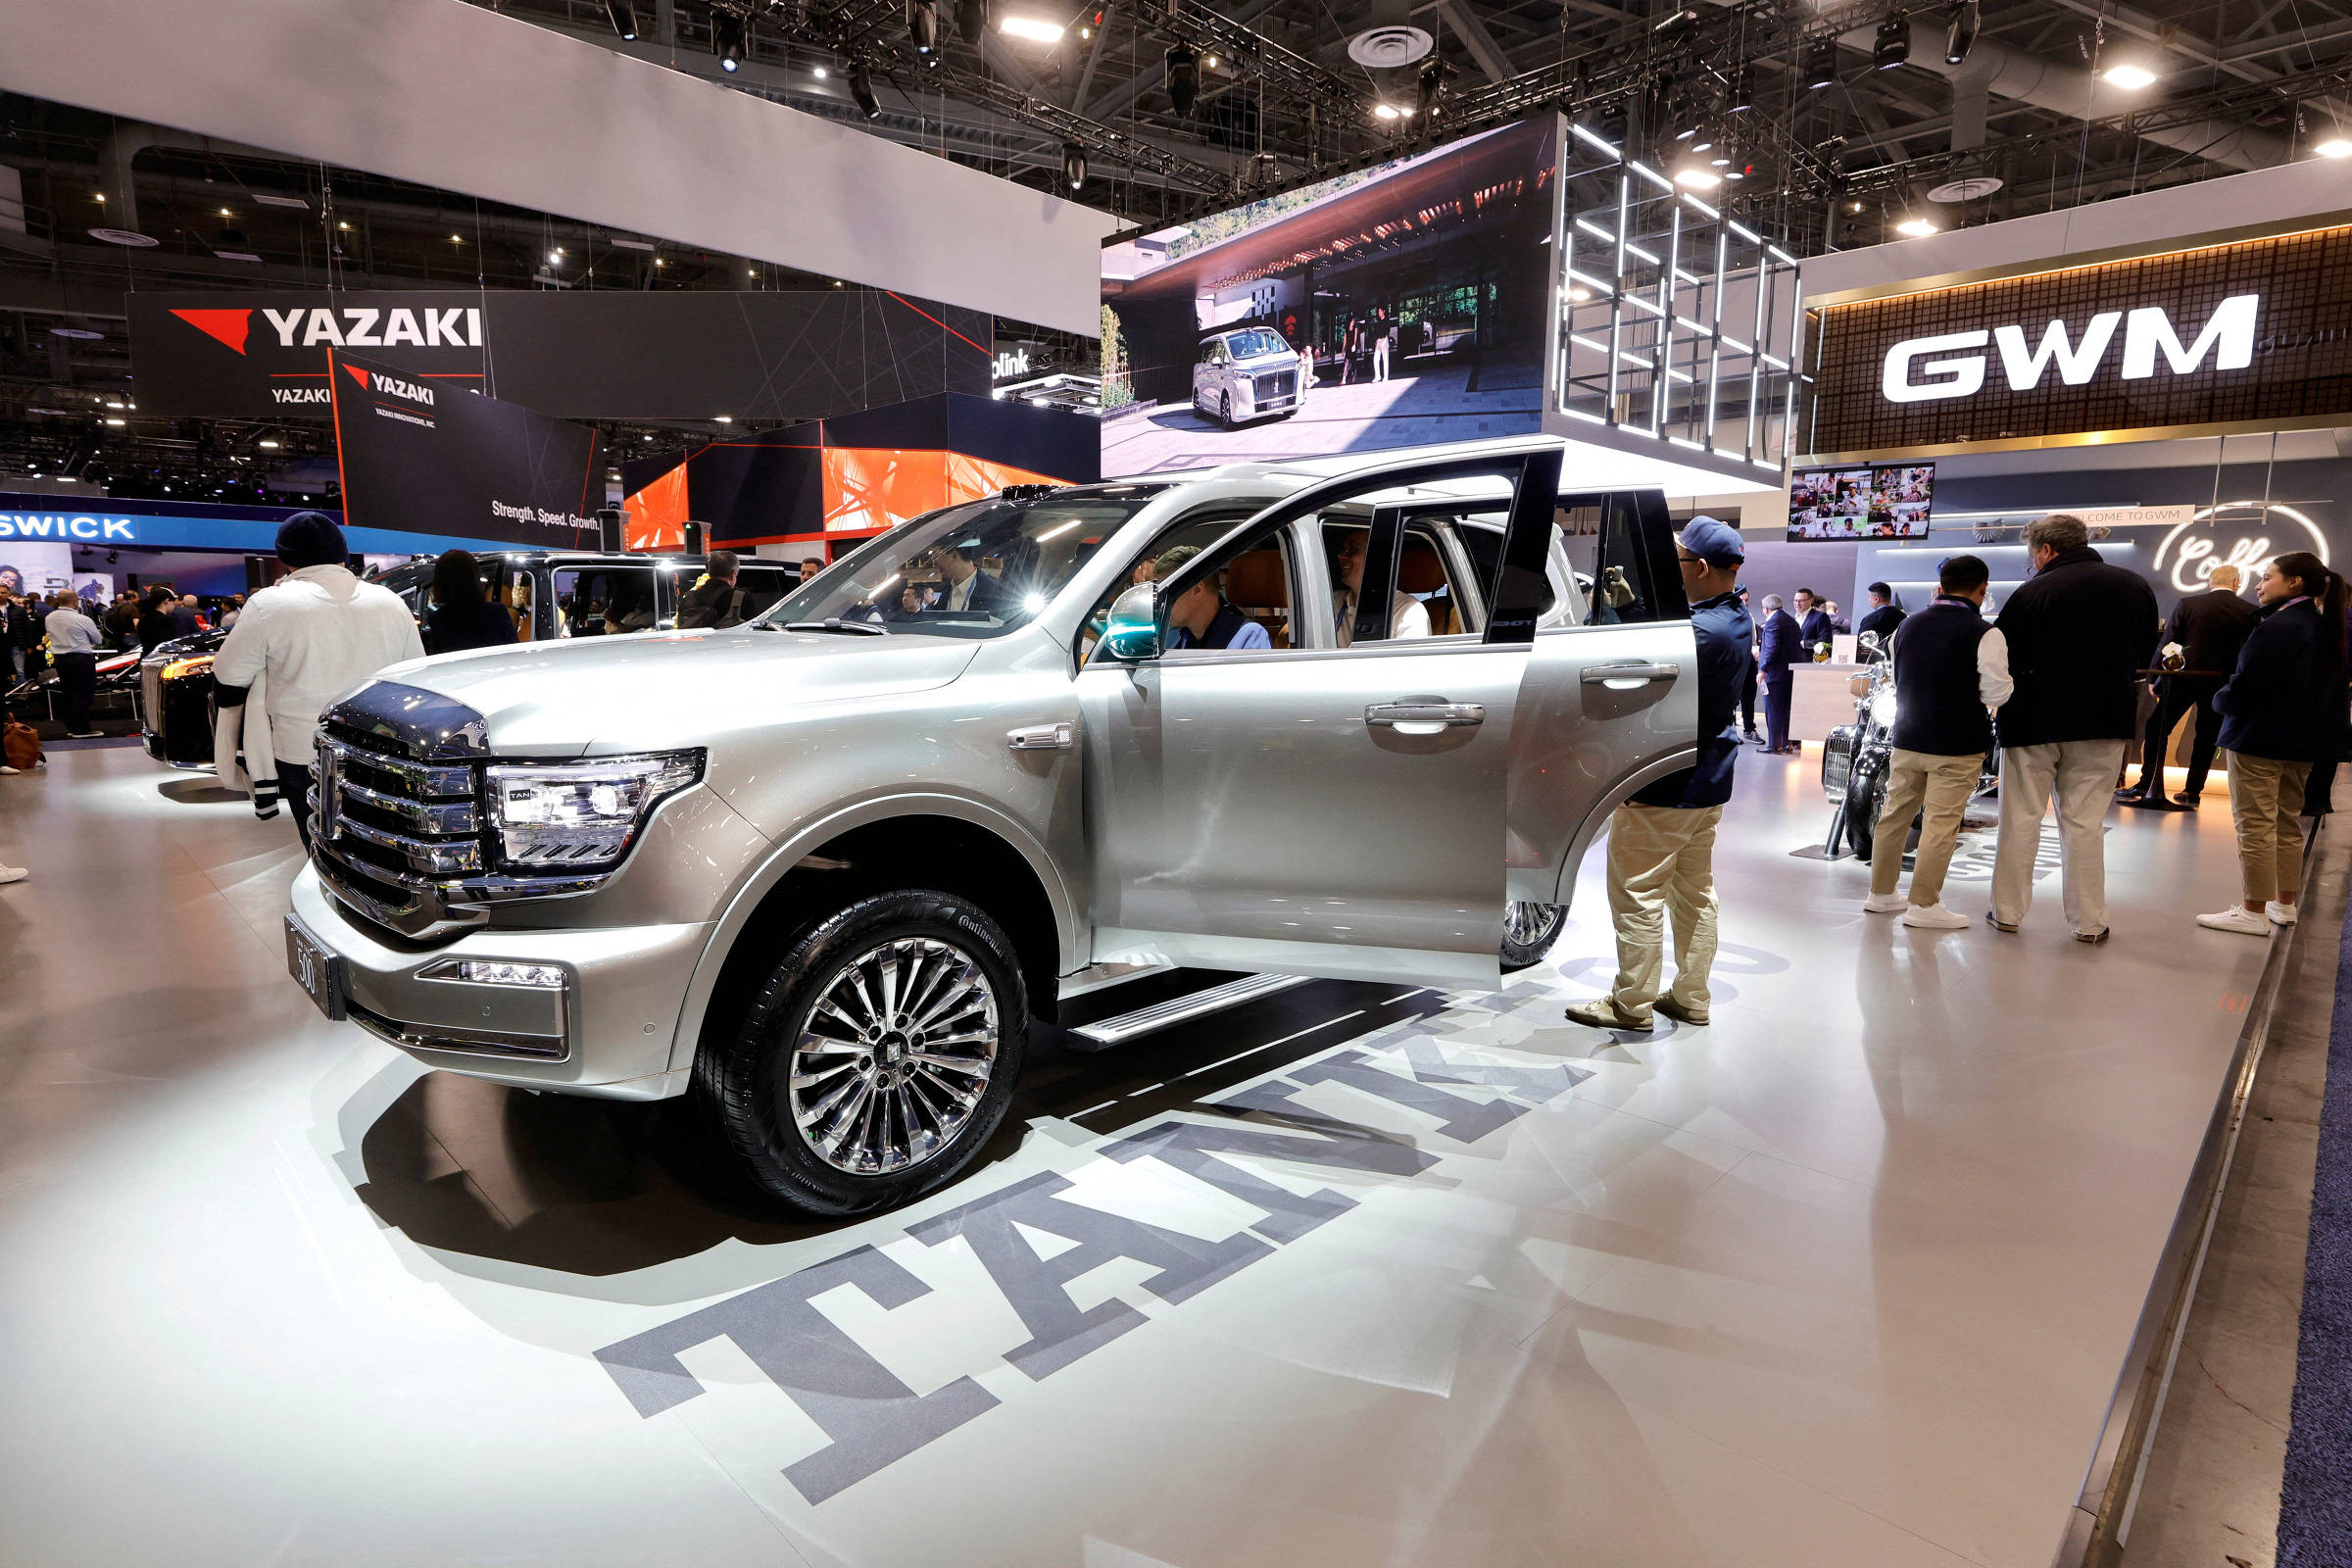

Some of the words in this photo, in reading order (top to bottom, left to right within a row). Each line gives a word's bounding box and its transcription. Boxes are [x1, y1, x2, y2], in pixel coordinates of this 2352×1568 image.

[262, 308, 483, 347] YAZAKI
[1883, 294, 2259, 403] GWM
[271, 388, 331, 403] YAZAKI
[370, 372, 435, 406] YAZAKI
[491, 500, 536, 523] Strength.
[538, 508, 567, 527] Speed.
[568, 513, 600, 531] Growth.
[2127, 512, 2143, 520] TO
[2144, 510, 2180, 520] GWM
[297, 947, 315, 995] 500
[592, 981, 1597, 1508] TANK
